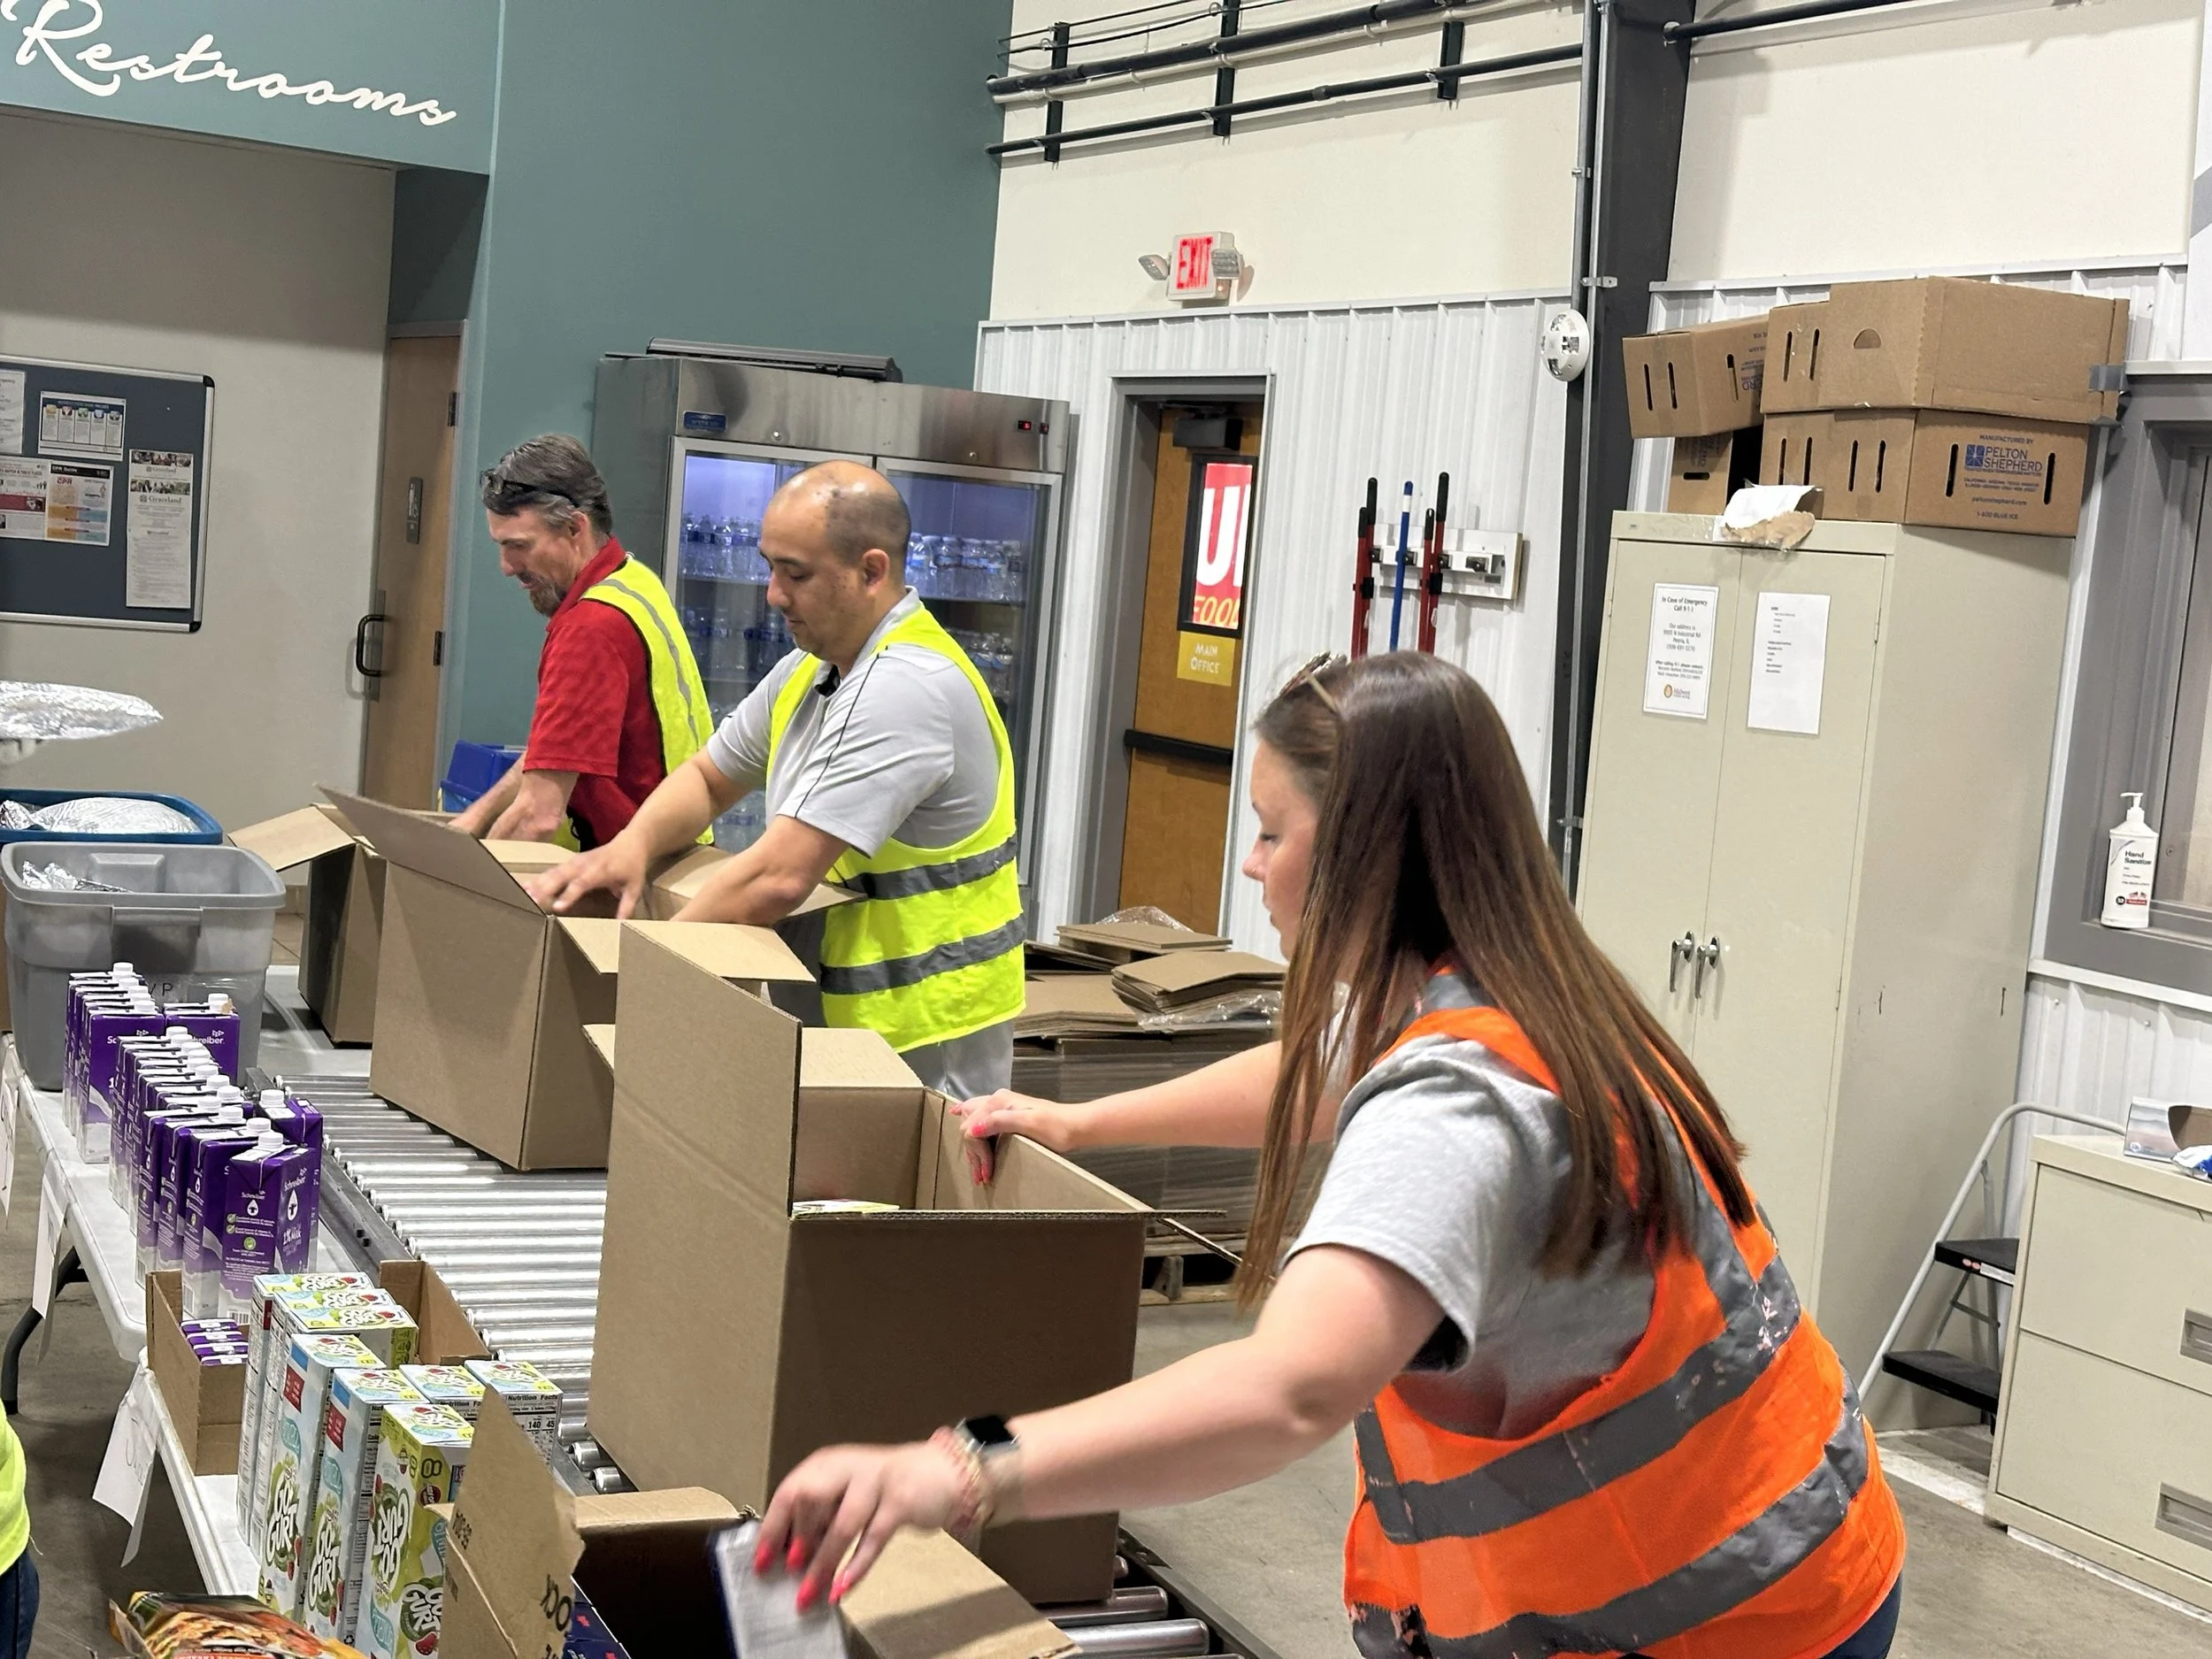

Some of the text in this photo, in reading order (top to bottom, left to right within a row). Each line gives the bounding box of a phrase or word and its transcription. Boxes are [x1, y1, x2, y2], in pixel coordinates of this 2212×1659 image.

[1, 0, 457, 126] Restrooms
[1979, 434, 2025, 443] MANUFACTURED
[1985, 446, 2028, 460] PELTON
[1984, 457, 2043, 472] SHEPHERD
[1972, 496, 2027, 506] peltonshepherd.com
[1194, 642, 1218, 657] MAIN
[1190, 657, 1219, 674] OFFICE
[2125, 850, 2144, 859] Hand
[192, 1035, 225, 1045] hreiber
[421, 1457, 442, 1479] 8
[373, 1488, 410, 1555] GURT
[265, 1503, 299, 1563] GURT
[310, 1546, 341, 1609] GURT
[400, 1583, 441, 1632] GURT
